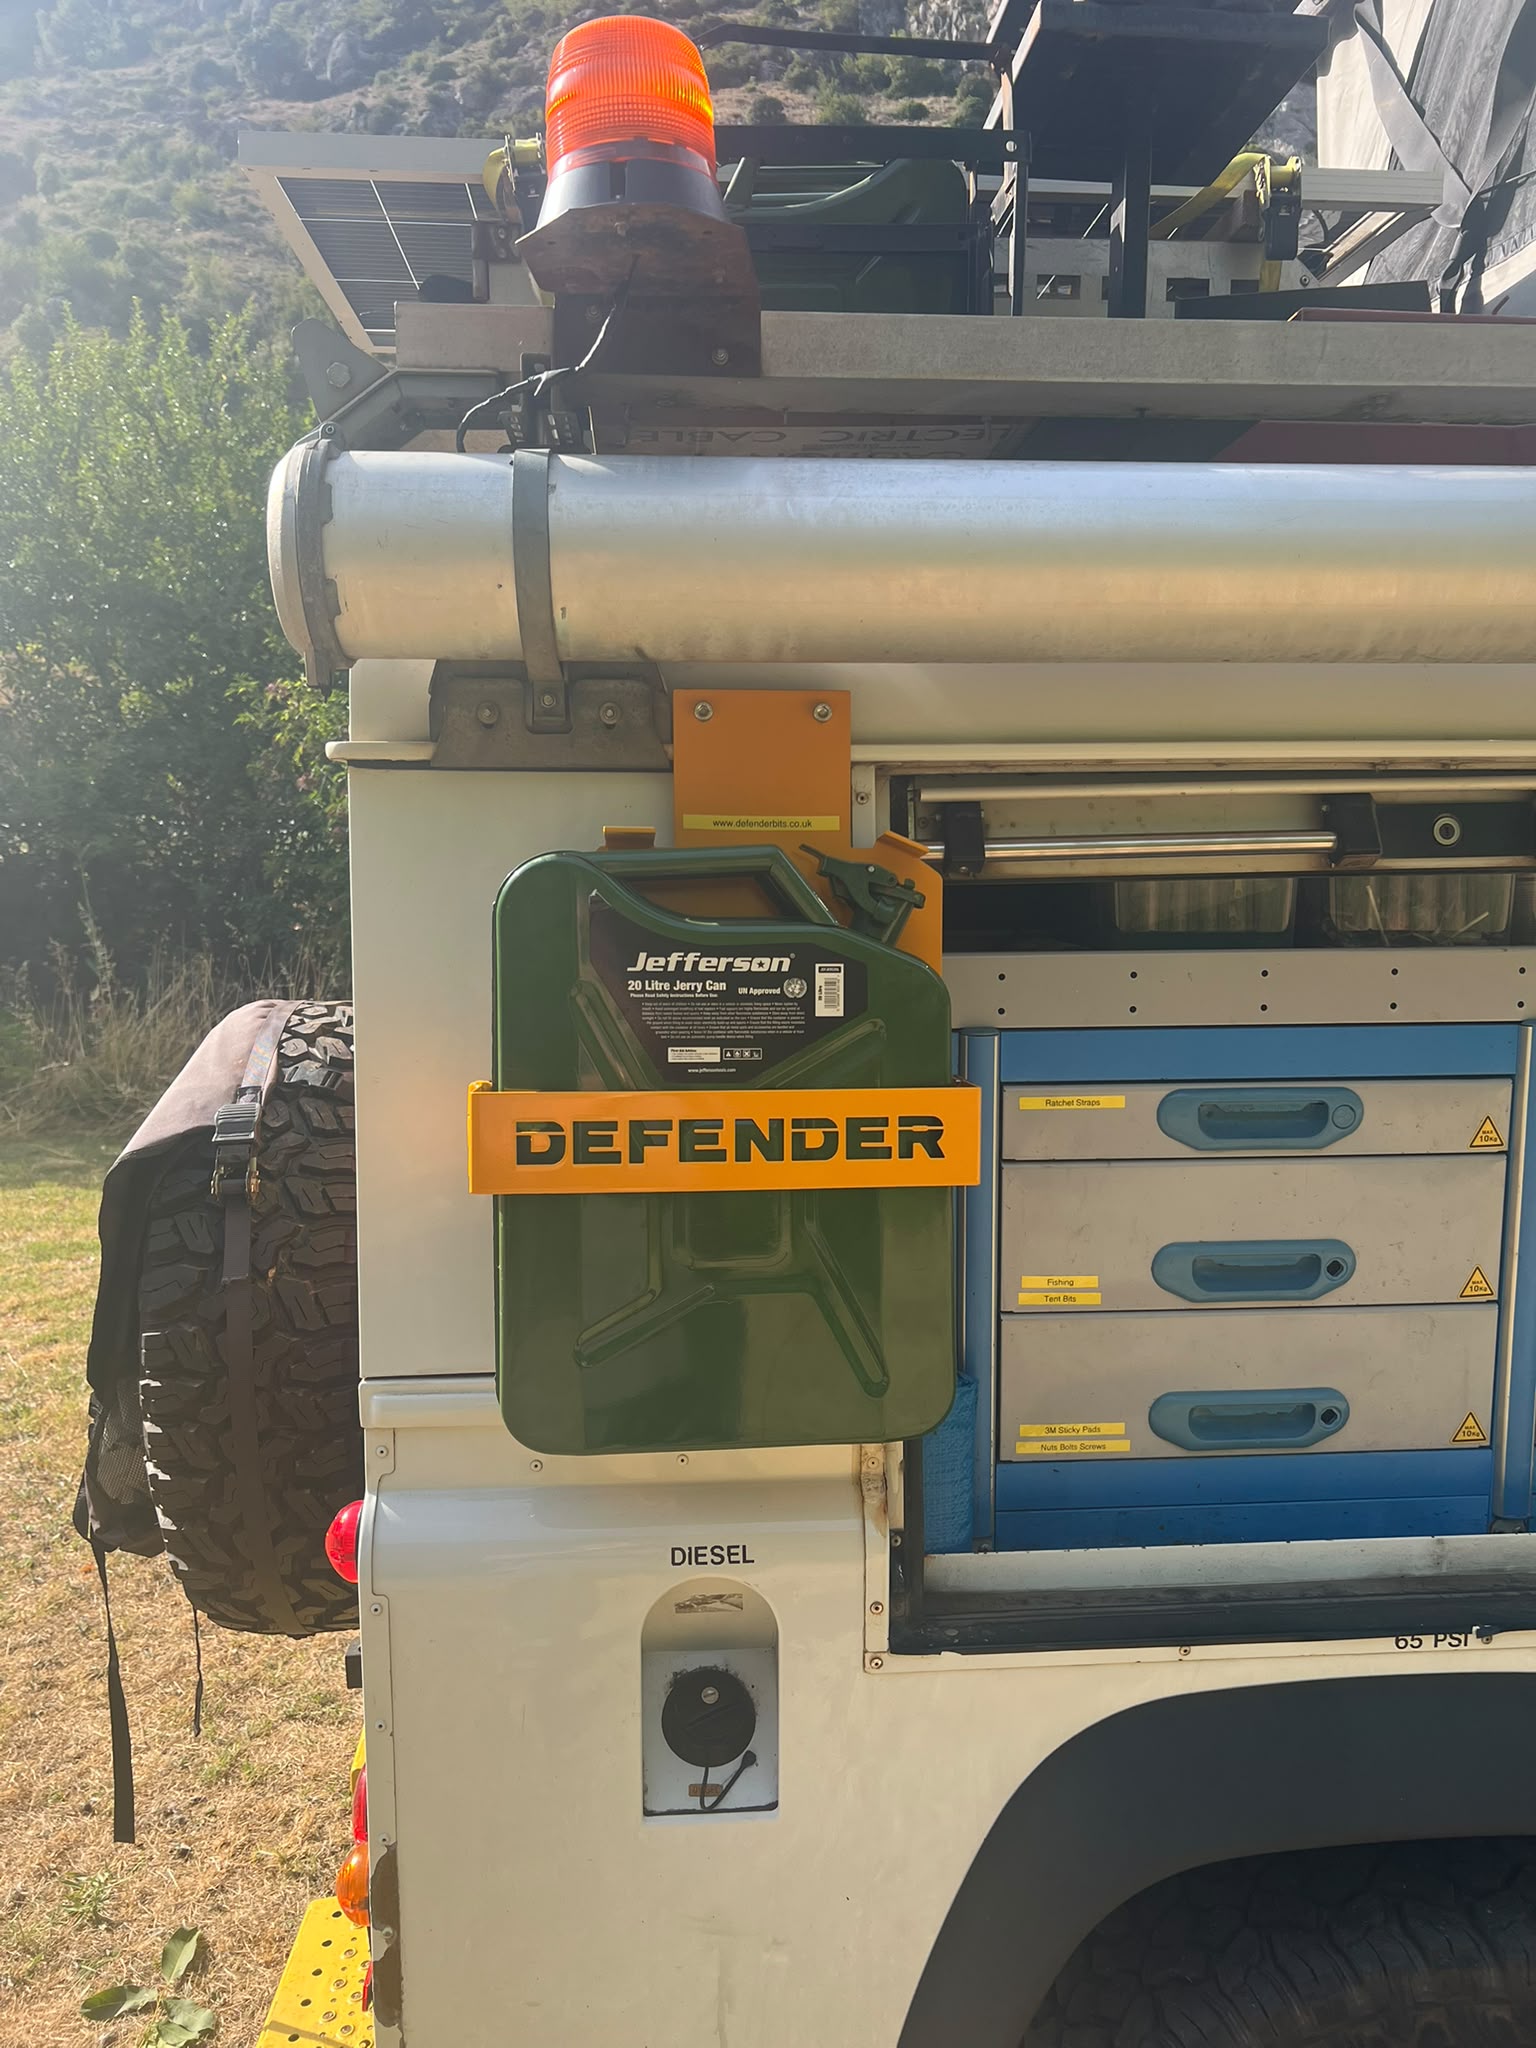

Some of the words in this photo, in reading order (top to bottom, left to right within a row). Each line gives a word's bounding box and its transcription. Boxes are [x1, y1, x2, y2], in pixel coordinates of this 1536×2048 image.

[712, 819, 813, 829] www.defenderbits.co.uk
[626, 952, 791, 972] Jefferson
[627, 980, 642, 991] 20
[645, 980, 670, 991] Litre
[673, 979, 703, 993] Jerry
[705, 979, 727, 991] Can
[738, 987, 748, 995] UN
[749, 986, 780, 996] Approved
[1045, 1098, 1074, 1107] Ratchet
[1076, 1097, 1101, 1108] Straps
[515, 1116, 946, 1166] DEFENDER
[1047, 1278, 1074, 1288] Fishing
[1045, 1295, 1062, 1303] Tent
[1063, 1295, 1076, 1303] Bits
[1044, 1426, 1057, 1435] 3M
[1058, 1425, 1081, 1436] Sticky
[1082, 1425, 1101, 1434] Pads
[1041, 1443, 1057, 1452] Nuts
[1059, 1443, 1077, 1452] Bolts
[1079, 1443, 1106, 1451] Screws
[670, 1544, 756, 1567] DIESEL
[1394, 1635, 1423, 1650] 65
[1433, 1632, 1469, 1648] PSI
